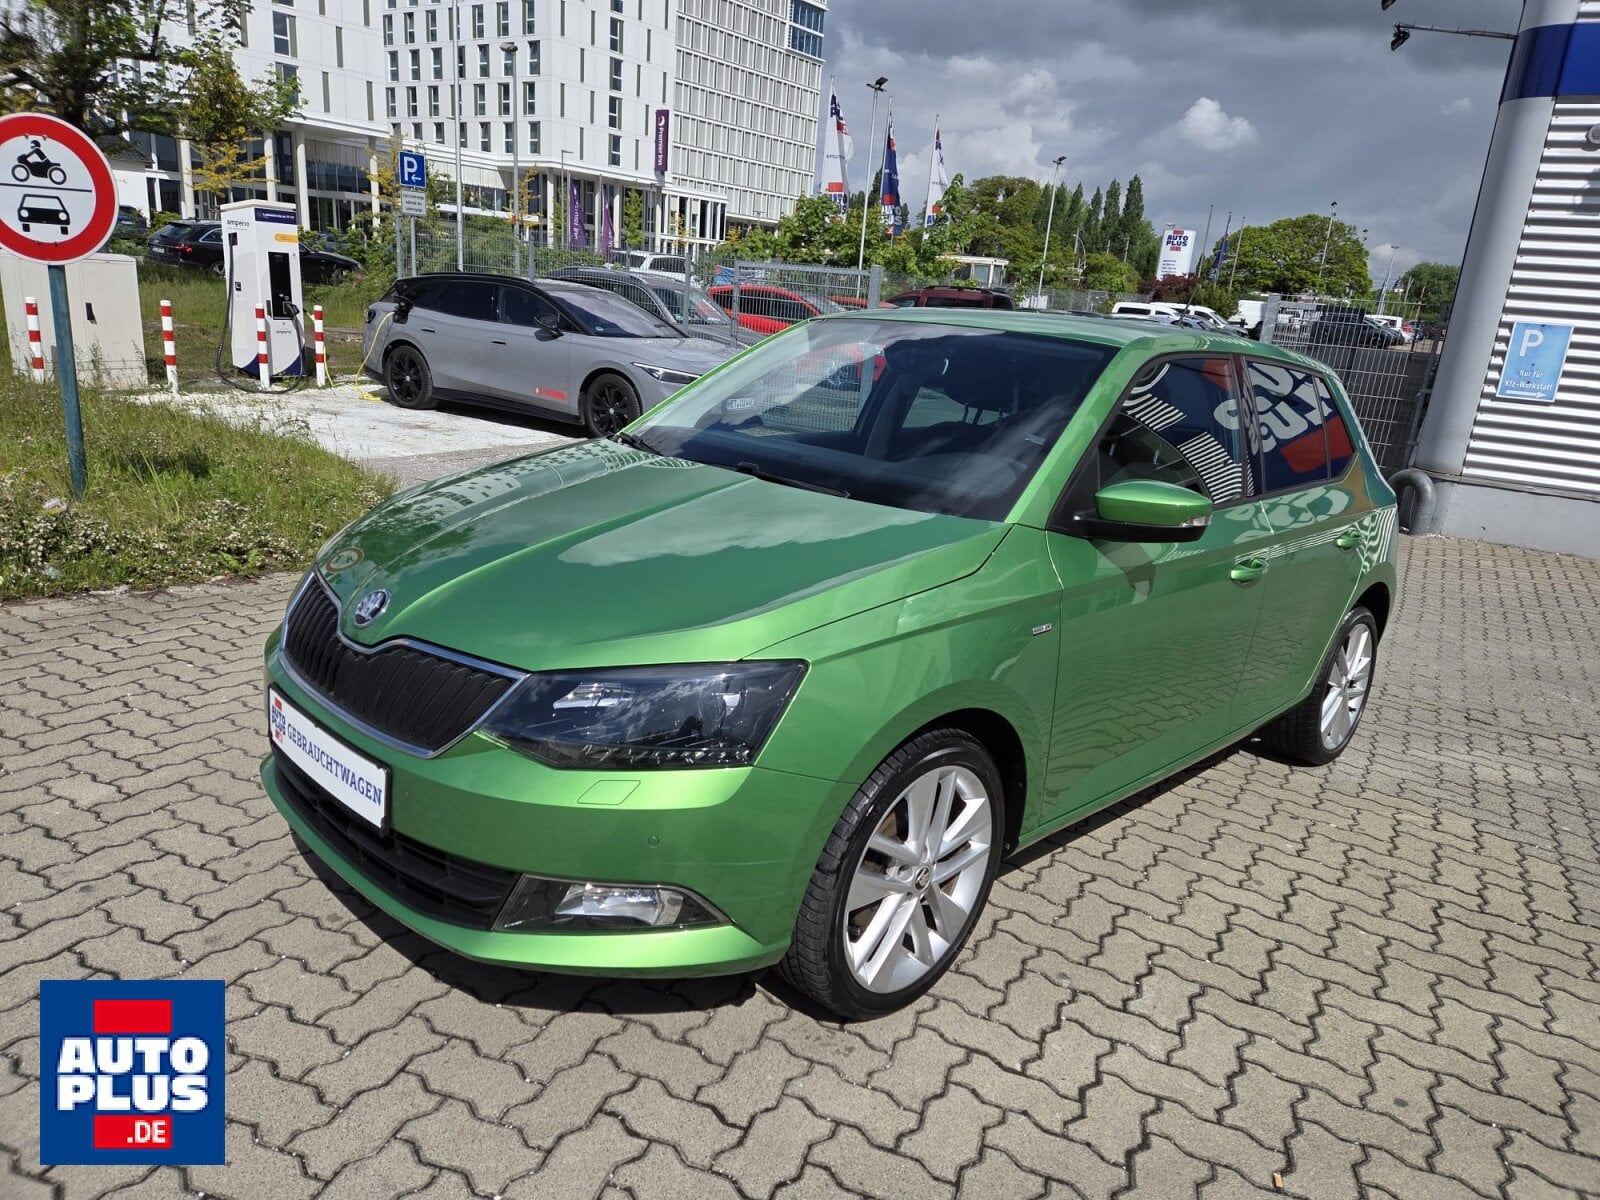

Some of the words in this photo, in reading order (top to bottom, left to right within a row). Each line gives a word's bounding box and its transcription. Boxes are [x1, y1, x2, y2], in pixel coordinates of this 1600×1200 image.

[403, 156, 418, 182] P
[226, 220, 250, 228] amperio
[1519, 329, 1544, 357] P
[1520, 369, 1532, 377] Nur
[1533, 370, 1545, 378] für
[1504, 380, 1553, 391] Kfz-Werkstatt
[287, 723, 382, 806] GEBRAUCHTWAGEN
